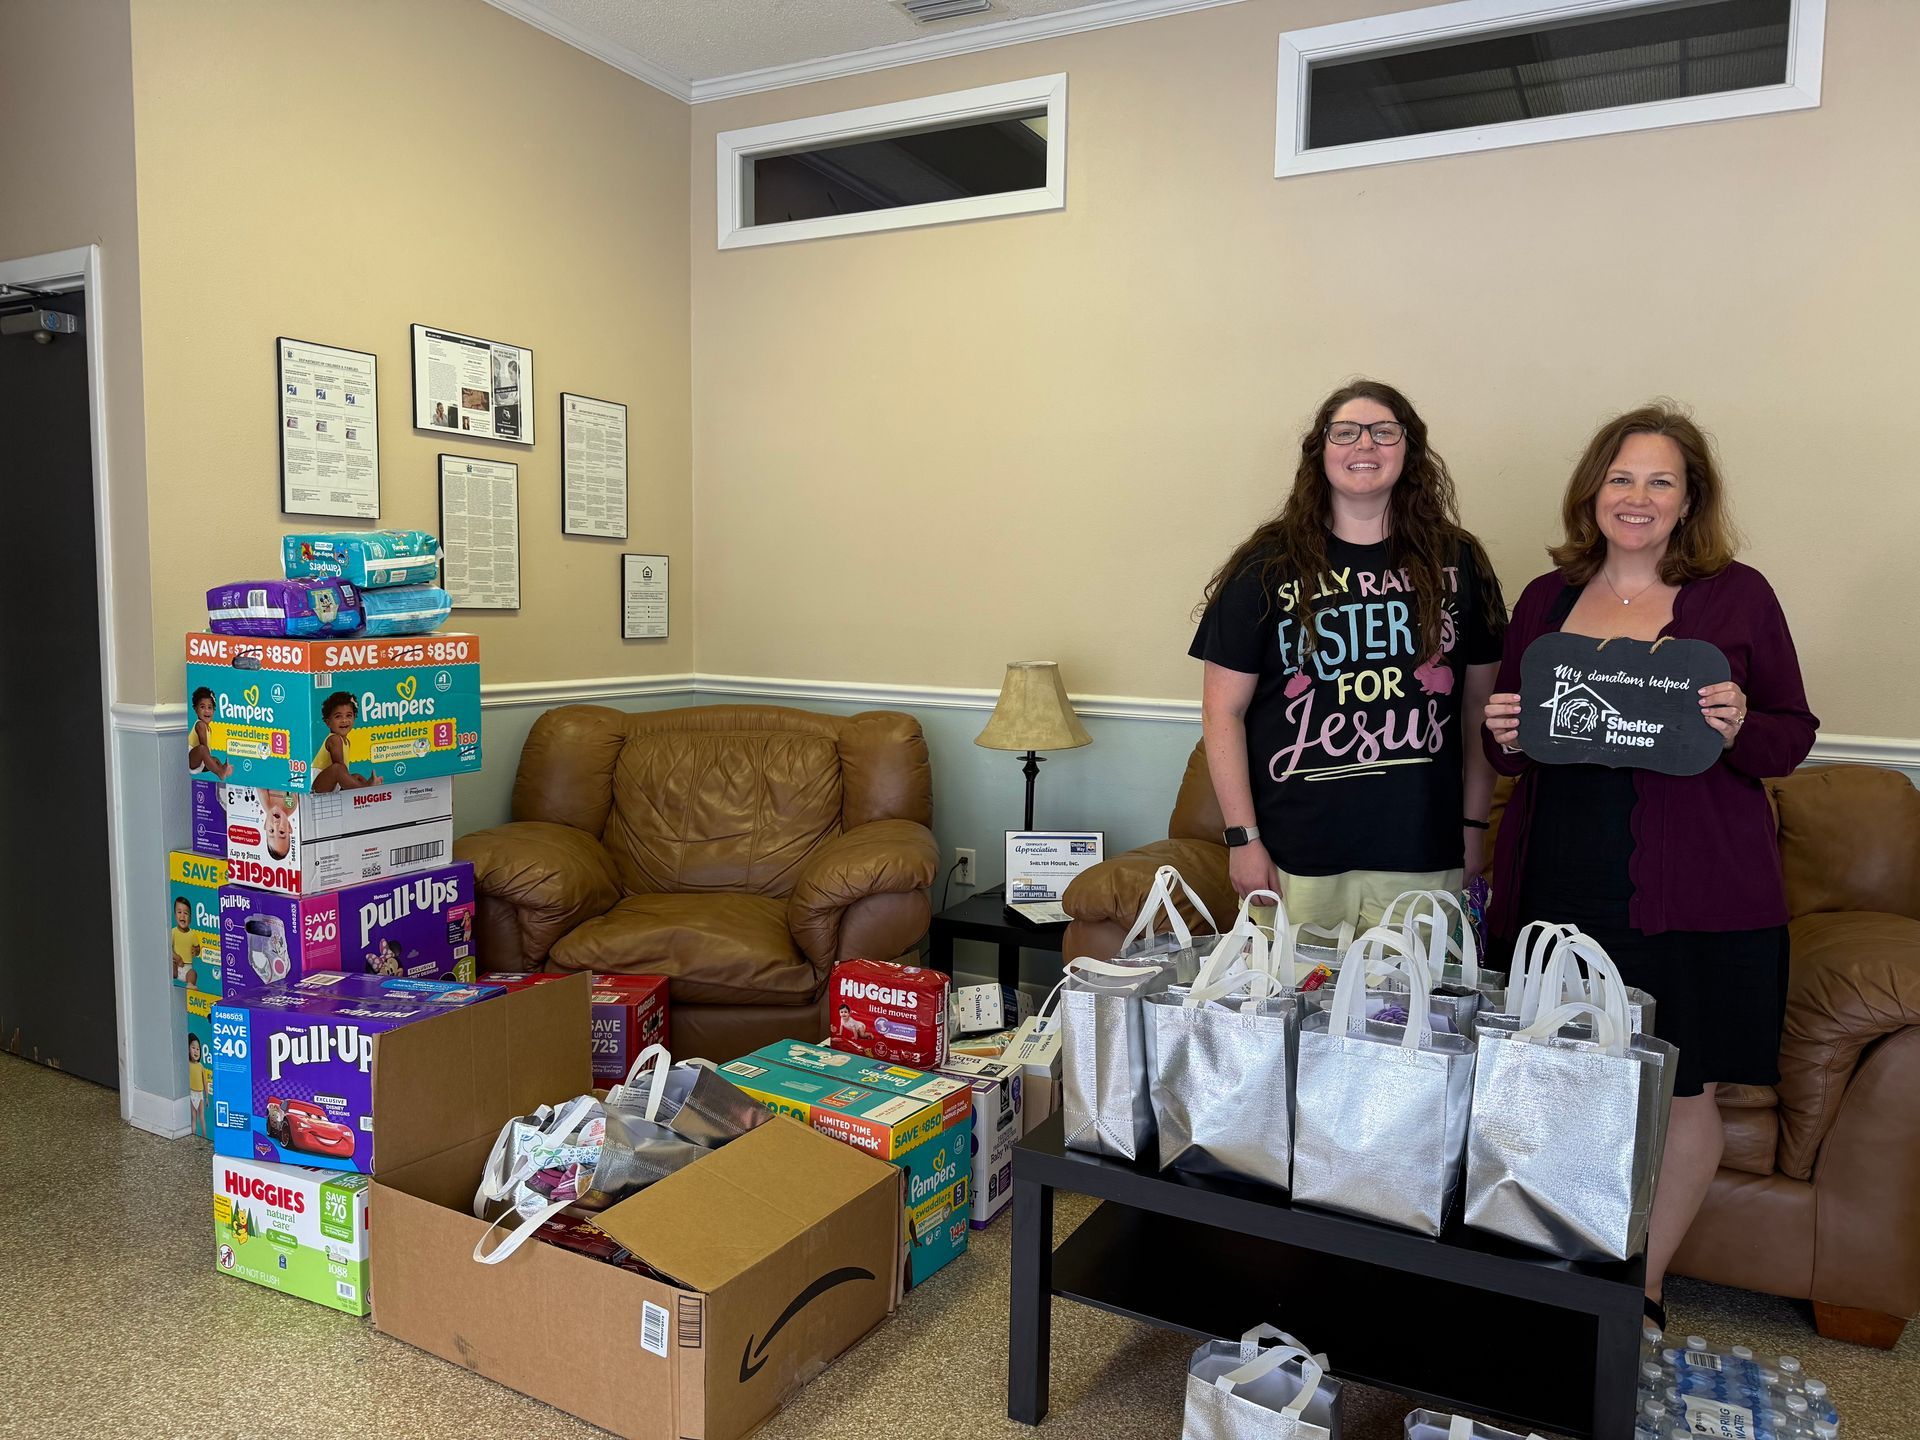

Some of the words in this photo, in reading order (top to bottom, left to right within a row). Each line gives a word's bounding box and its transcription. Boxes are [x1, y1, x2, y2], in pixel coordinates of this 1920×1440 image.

[309, 561, 341, 577] Pampers
[1278, 566, 1351, 612] SILY
[189, 639, 227, 658] SAVE
[1277, 601, 1415, 681] EASTER
[325, 645, 378, 667] SAVE
[438, 674, 446, 683] #1
[1338, 667, 1405, 705] FOR
[1553, 663, 1582, 683] My
[1588, 669, 1645, 688] donations
[1649, 676, 1690, 693] helped
[219, 693, 274, 724] Pampers
[361, 692, 435, 722] Pampers
[439, 725, 447, 739] 3
[1606, 716, 1664, 734] Shelter
[226, 728, 270, 740] swaddlers
[276, 734, 282, 746] 3
[370, 727, 428, 741] swaddlers
[458, 732, 478, 744] 180
[1269, 689, 1451, 783] Jesus
[1605, 731, 1655, 748] House
[385, 751, 412, 759] protection
[288, 760, 306, 773] 180
[228, 791, 235, 805] 3
[353, 792, 392, 806] HUGGIES
[229, 848, 241, 857] dry
[247, 851, 261, 861] snug
[1015, 846, 1058, 854] Appreciation
[182, 861, 218, 883] SAVE
[228, 860, 301, 894] HUGGIES
[305, 910, 336, 926] SAVE
[305, 923, 337, 943] $40
[409, 962, 435, 974] EXCLUSIVE
[458, 962, 471, 974] 2T
[458, 973, 471, 983] 3T
[840, 978, 918, 1009] HUGGIES
[189, 996, 206, 1009] SAVE
[868, 1004, 887, 1015] little
[888, 1010, 917, 1020] movers
[213, 1023, 247, 1037] SAVE
[213, 1036, 247, 1059] $40
[912, 1053, 920, 1063] 3
[858, 1068, 913, 1088] Pampers
[316, 1096, 345, 1105] EXCLUSIVE
[813, 1120, 848, 1140] bonus
[819, 1115, 850, 1130] LIMITED
[852, 1123, 871, 1136] TIME
[894, 1125, 918, 1149] SAVE
[921, 1113, 942, 1133] $850
[990, 1147, 1004, 1165] Baby
[911, 1162, 956, 1202] Pampers
[956, 1185, 962, 1195] 5
[225, 1169, 305, 1214] HUGGIES
[325, 1191, 347, 1205] SAVE
[326, 1202, 347, 1220] $70
[915, 1192, 951, 1219] swaddlers
[266, 1209, 296, 1224] natural
[272, 1220, 290, 1231] care
[950, 1218, 967, 1242] 144
[235, 1265, 245, 1276] DO
[245, 1267, 259, 1278] NOT
[259, 1272, 279, 1286] FLUSH
[328, 1264, 348, 1278] 1088
